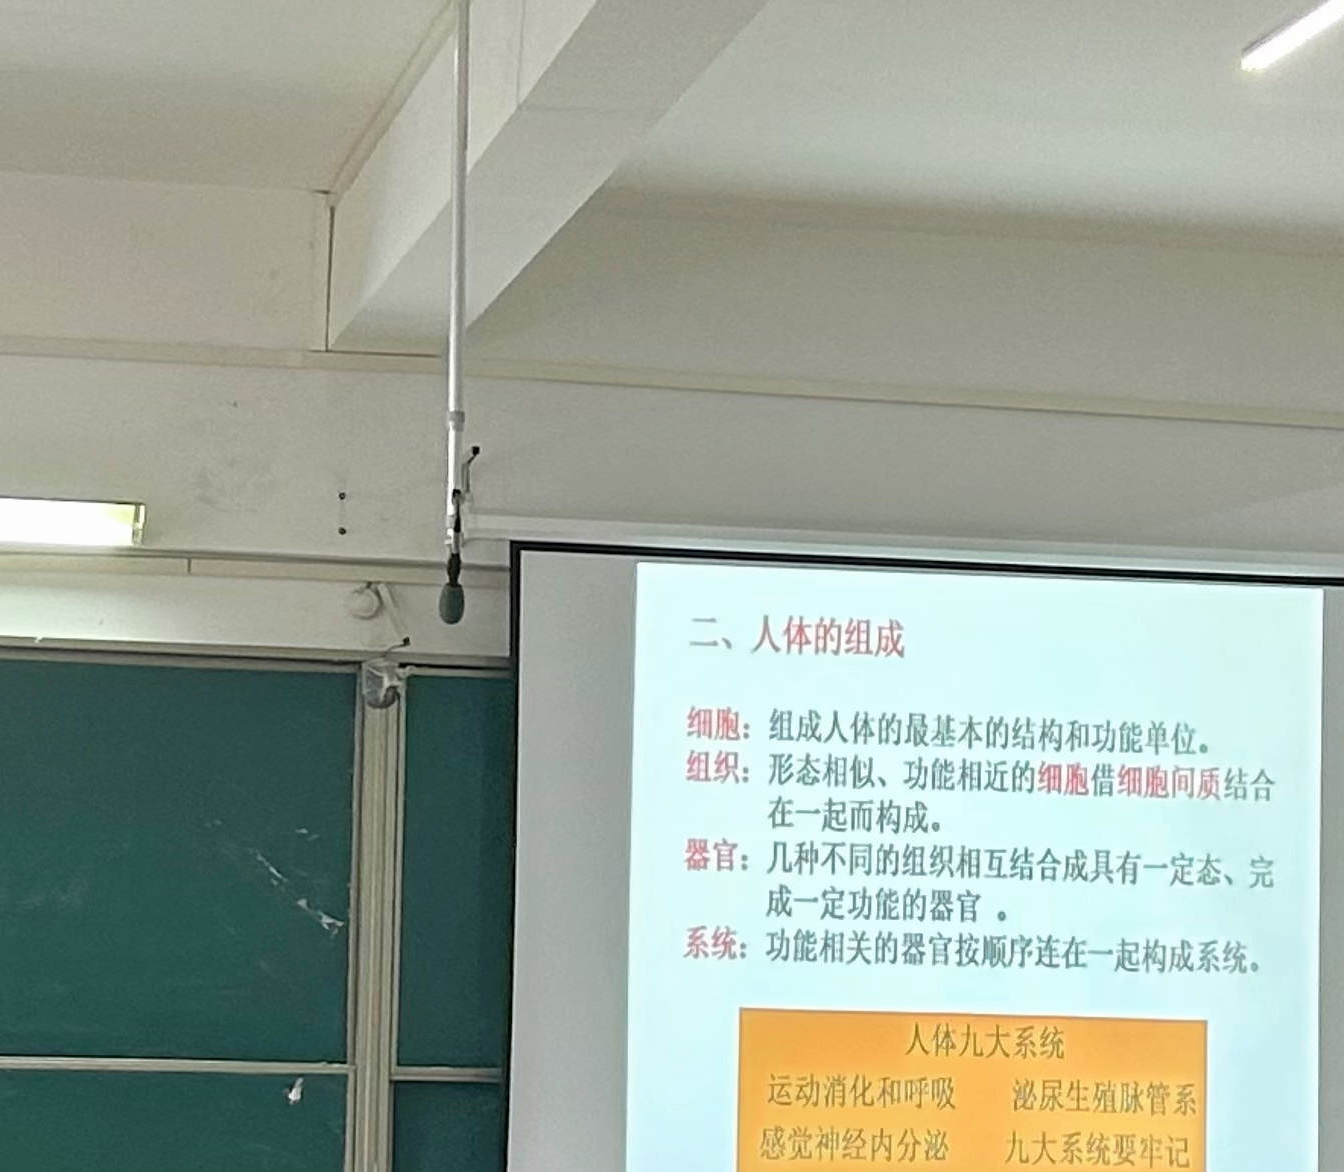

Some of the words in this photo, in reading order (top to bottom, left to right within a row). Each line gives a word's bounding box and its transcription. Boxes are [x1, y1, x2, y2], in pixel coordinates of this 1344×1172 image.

[689, 614, 906, 659] 二、人体的组成
[768, 795, 941, 834] 在一起而构成。
[905, 1021, 1065, 1060] 人体九大系统
[767, 1073, 956, 1110] 运动消化和呼吸
[1012, 1077, 1197, 1116] 泌尿生殖脉管系
[760, 1125, 949, 1162] 感觉神经内分泌
[1004, 1129, 1190, 1169] 九大系统要牢记
